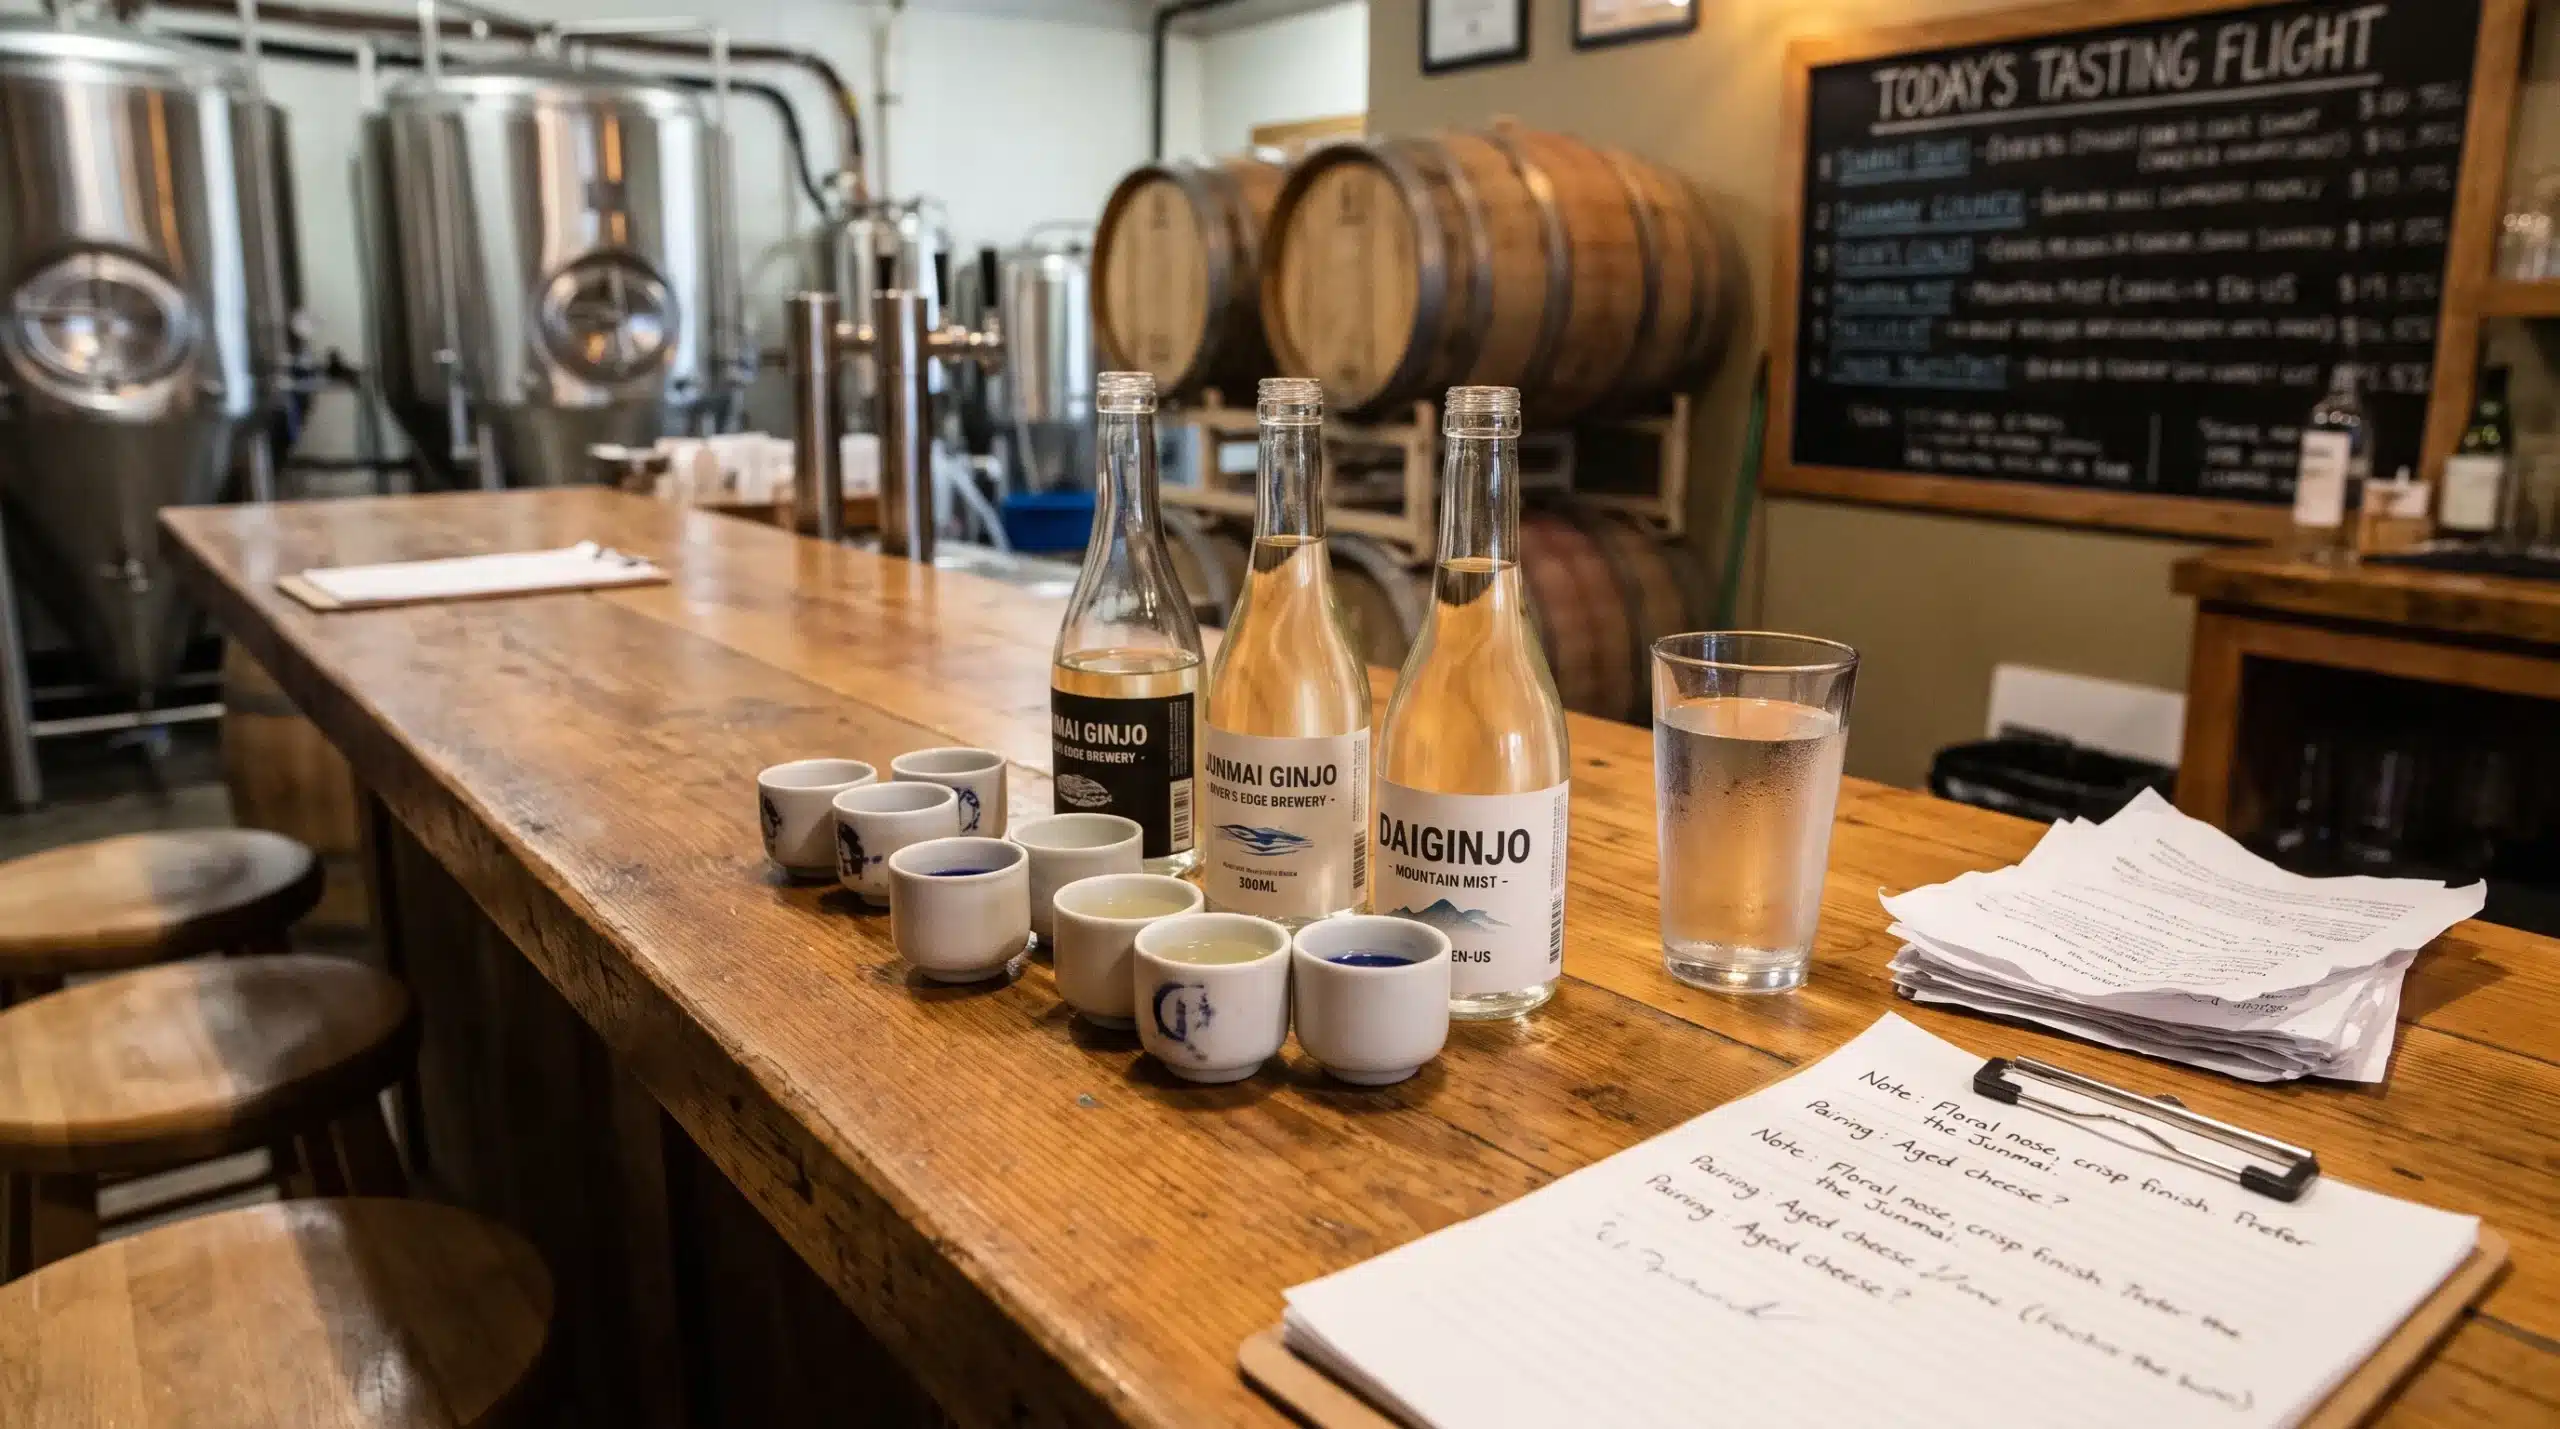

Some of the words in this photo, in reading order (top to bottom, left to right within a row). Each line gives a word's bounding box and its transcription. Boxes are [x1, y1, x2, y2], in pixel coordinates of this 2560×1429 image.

[1871, 51, 2019, 120] TODAY'S
[2030, 28, 2200, 103] TASTING
[2213, 4, 2389, 86] FLIGHT
[1084, 722, 1148, 746] GINJO
[1086, 750, 1136, 764] BREWERY
[1205, 752, 1262, 786] JUNMAI
[1269, 764, 1337, 788] GINJO
[1240, 792, 1268, 807] EDGE
[1271, 795, 1327, 808] BREWERY
[1379, 812, 1530, 866] DAIGINJO
[1239, 876, 1278, 893] 300ML
[1396, 863, 1459, 888] MOUNTAIN
[1463, 875, 1498, 888] MIST
[1451, 950, 1491, 963] EN-US
[1923, 1116, 1958, 1136] the
[1892, 1140, 1959, 1168] Aged
[1931, 1100, 2002, 1133] Floral
[2005, 1132, 2061, 1161] nose,
[2073, 1157, 2130, 1184] crisp
[1816, 1176, 1852, 1200] the
[1776, 1199, 1841, 1232] Aged
[1827, 1161, 1898, 1196] Floral
[1965, 1223, 2024, 1252] crisp
[1732, 1221, 1801, 1256] Aged
